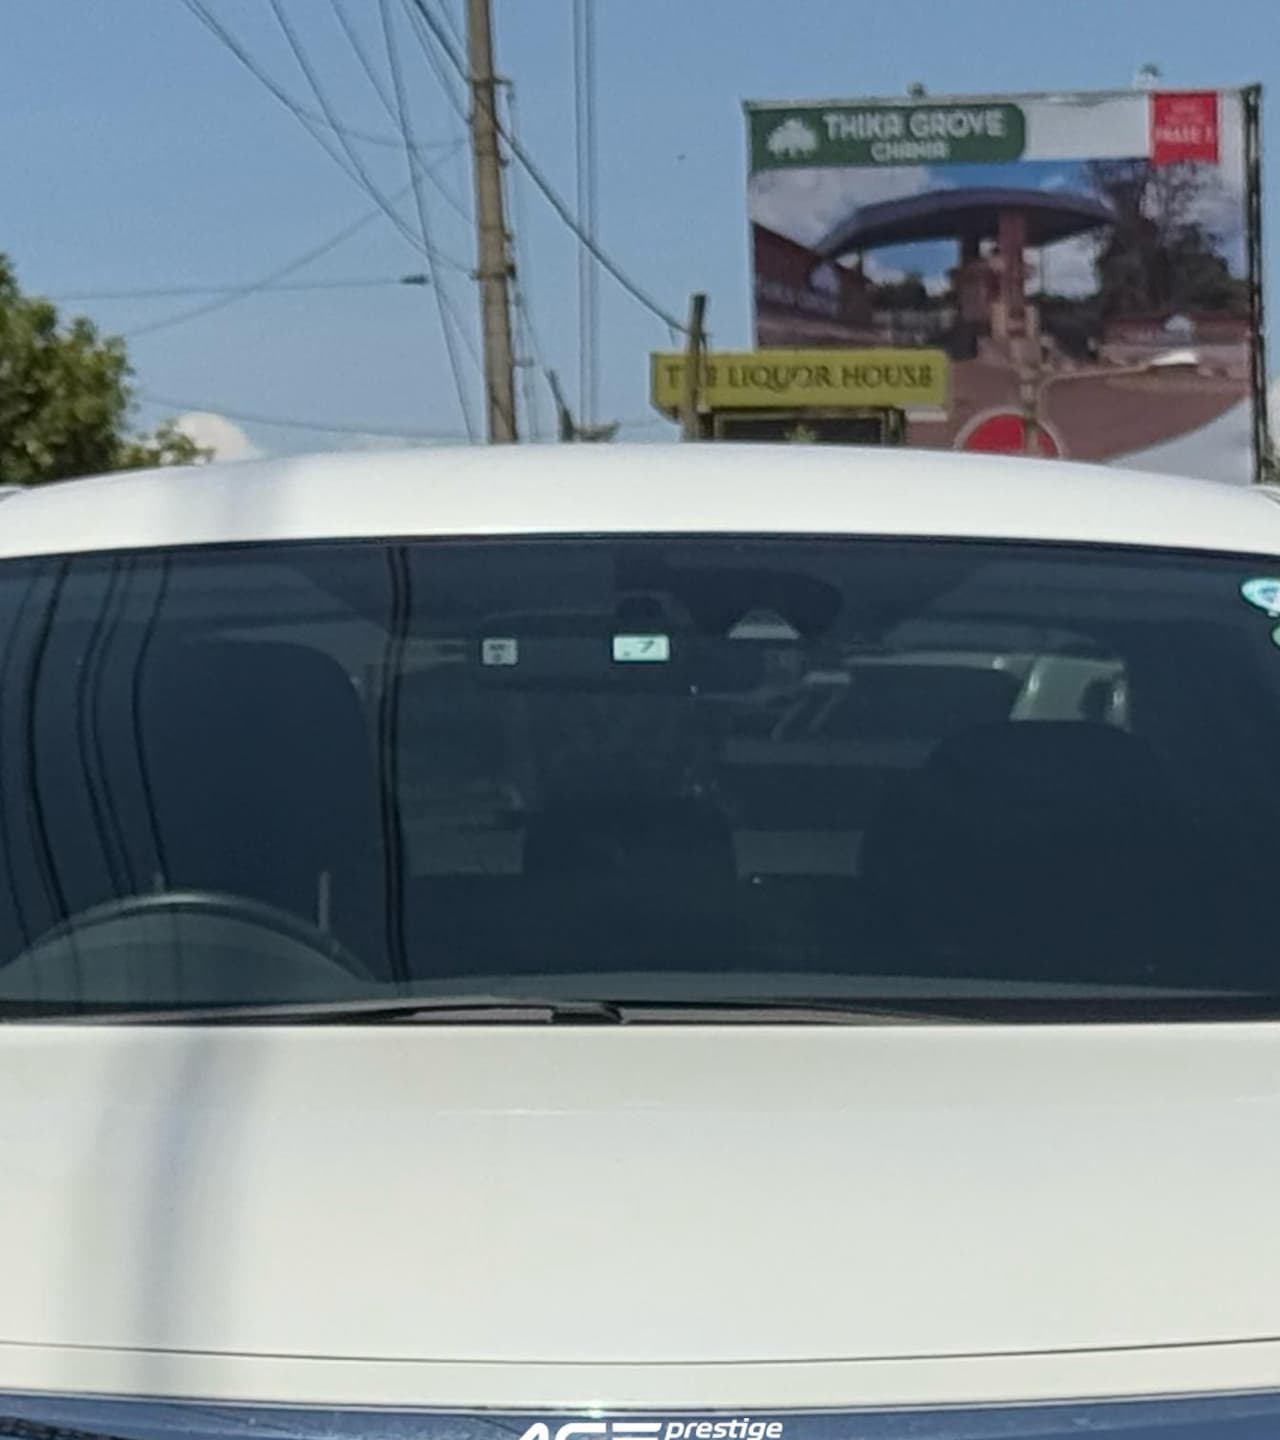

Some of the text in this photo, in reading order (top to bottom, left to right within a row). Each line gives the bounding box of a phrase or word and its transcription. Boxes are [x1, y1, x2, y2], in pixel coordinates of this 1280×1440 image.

[823, 108, 1007, 140] THIKA GROVE
[728, 363, 833, 392] LIQUOR
[840, 363, 933, 389] HOUSE
